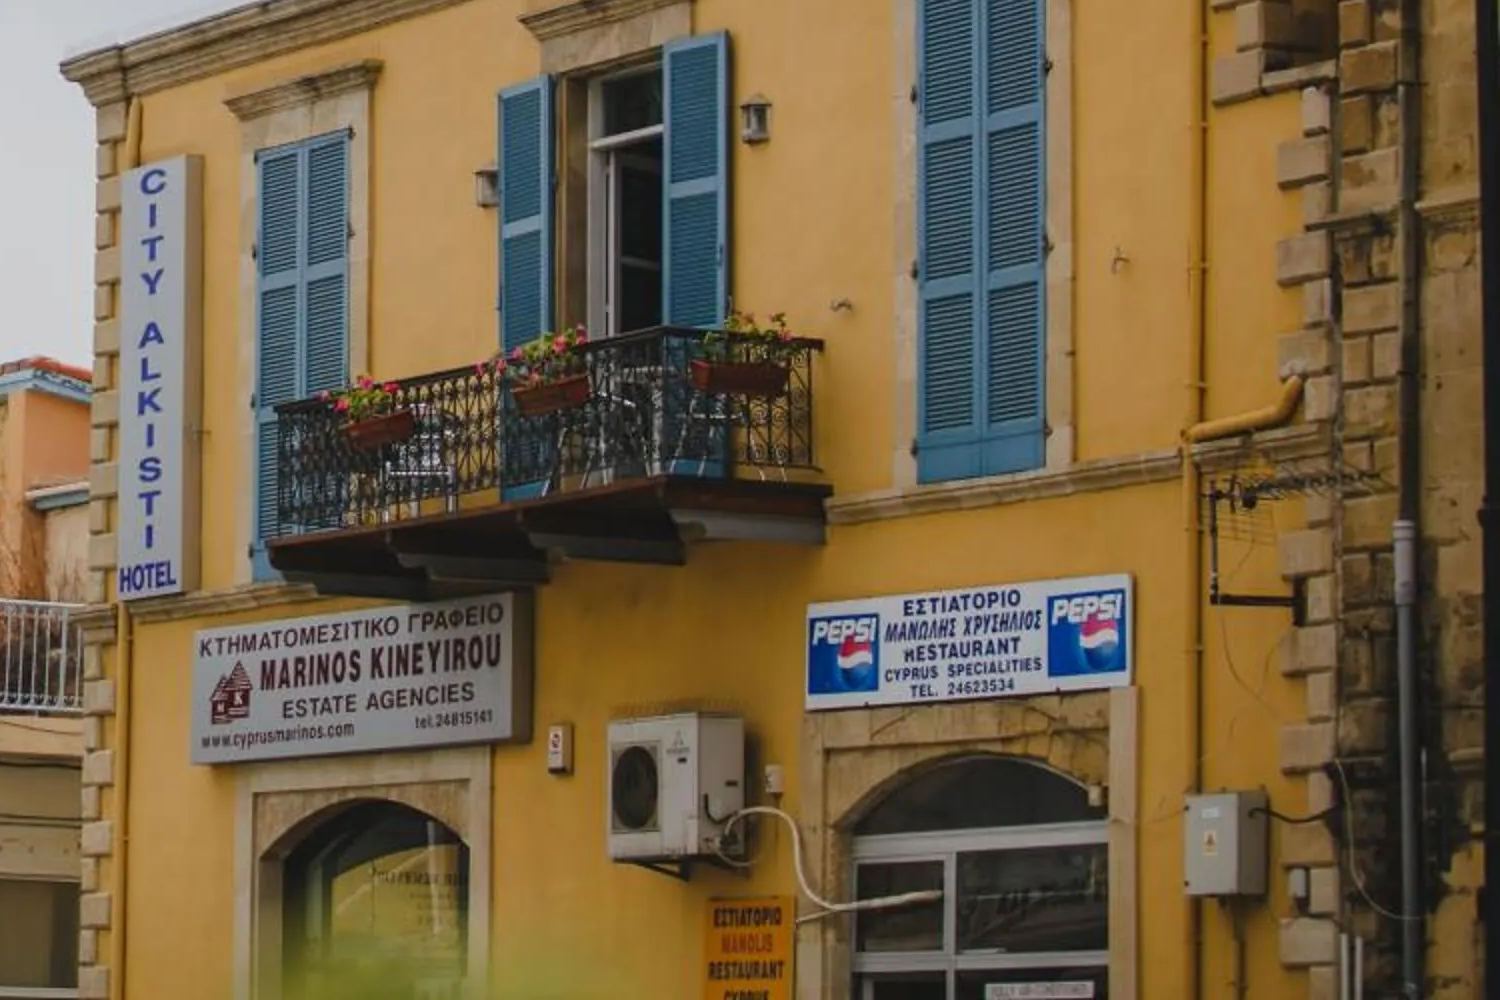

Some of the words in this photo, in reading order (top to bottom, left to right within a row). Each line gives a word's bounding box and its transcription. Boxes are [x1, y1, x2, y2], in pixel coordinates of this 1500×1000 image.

[140, 169, 166, 295] CITY
[137, 321, 165, 549] ALKISTI
[119, 561, 176, 593] HOTEL
[903, 589, 1021, 616] ΕΣΤΙΑΤΟΡΙΟ
[1051, 593, 1123, 626] PEPSI
[200, 616, 399, 657] ΚΤΗΜΑΤΟΜΕΣΙΤΙΚΟ
[408, 603, 503, 633] ΓΡΑΦΕΙΟ
[812, 617, 877, 646] PEPSI
[884, 617, 957, 643] ΜΑΝΩΛΗΣ
[260, 649, 361, 691] MARINOS
[370, 633, 501, 680] KINEYIROU
[884, 666, 939, 682] CYPRUS
[947, 657, 1042, 678] SPECIALITIES
[283, 693, 357, 719] ESTATE
[366, 682, 475, 711] AGENCIES
[910, 684, 938, 698] TEL.
[708, 960, 784, 980] RESTAURANT
